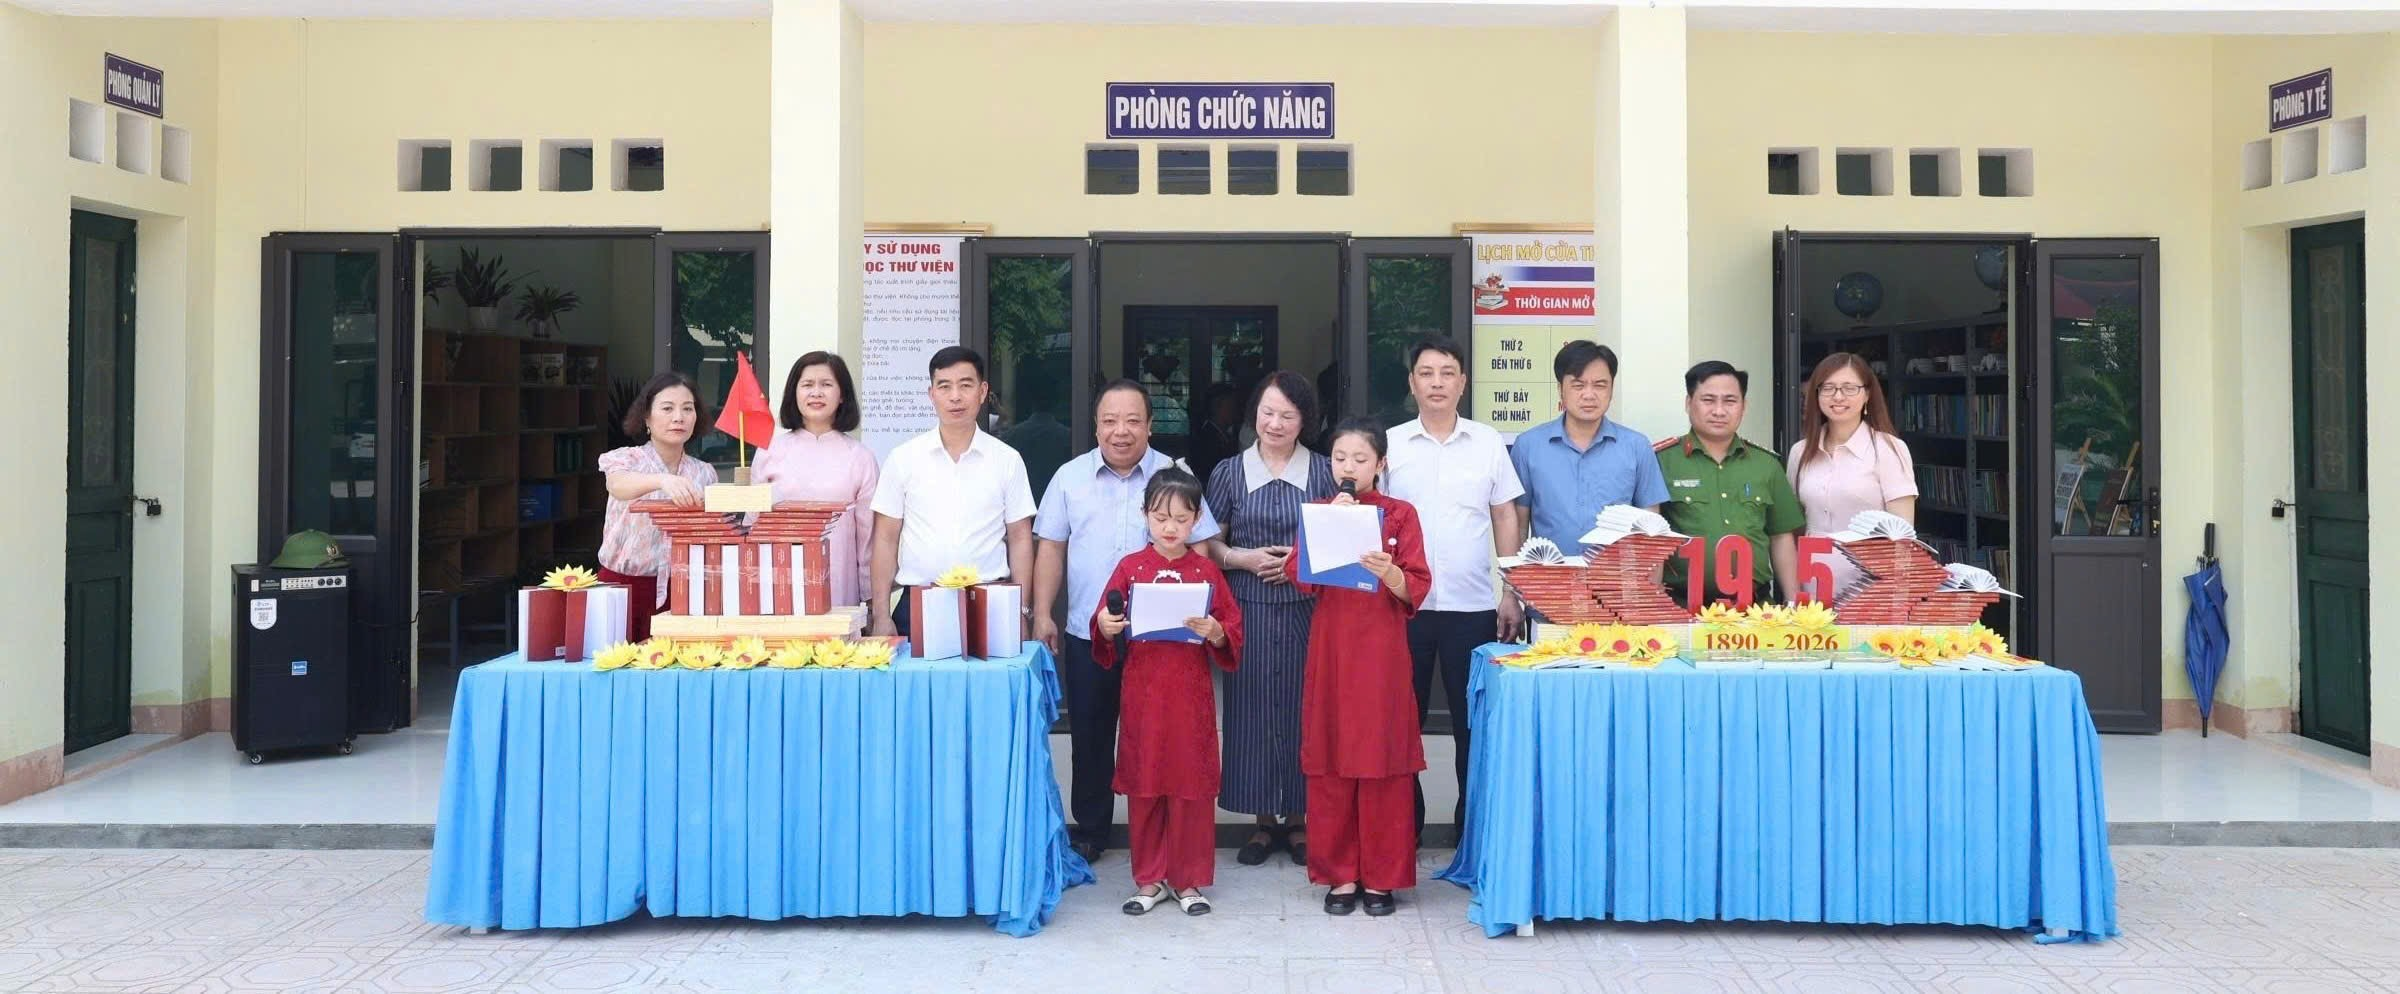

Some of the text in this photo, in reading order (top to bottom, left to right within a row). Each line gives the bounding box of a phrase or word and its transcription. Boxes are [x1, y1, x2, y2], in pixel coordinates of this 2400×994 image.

[108, 65, 160, 108] PHÒNG QUẢN LÝ
[2273, 76, 2327, 123] PHÒNG Y TẾ
[1115, 89, 1325, 129] PHÒNG CHỨC NĂNG
[877, 240, 897, 255] SỬ
[901, 243, 941, 257] DỤNG
[1477, 244, 1512, 264] LỊCH
[1516, 240, 1543, 261] MỞ
[1545, 240, 1578, 261] CỬA
[863, 259, 955, 275] ỌC THƯ VIỆN
[1514, 294, 1541, 309] THỜI
[1542, 297, 1569, 309] GIAN
[1571, 295, 1590, 309] MỞ
[1500, 338, 1523, 352] THỨ 2
[1491, 355, 1532, 370] ĐẾN THỨ 6
[1494, 387, 1529, 403] THỨ BẢY
[1491, 407, 1531, 424] CHỦ NHẬT
[1679, 534, 1834, 616] 19 5
[1704, 632, 1759, 651] 1890
[1783, 632, 1839, 651] 2026
